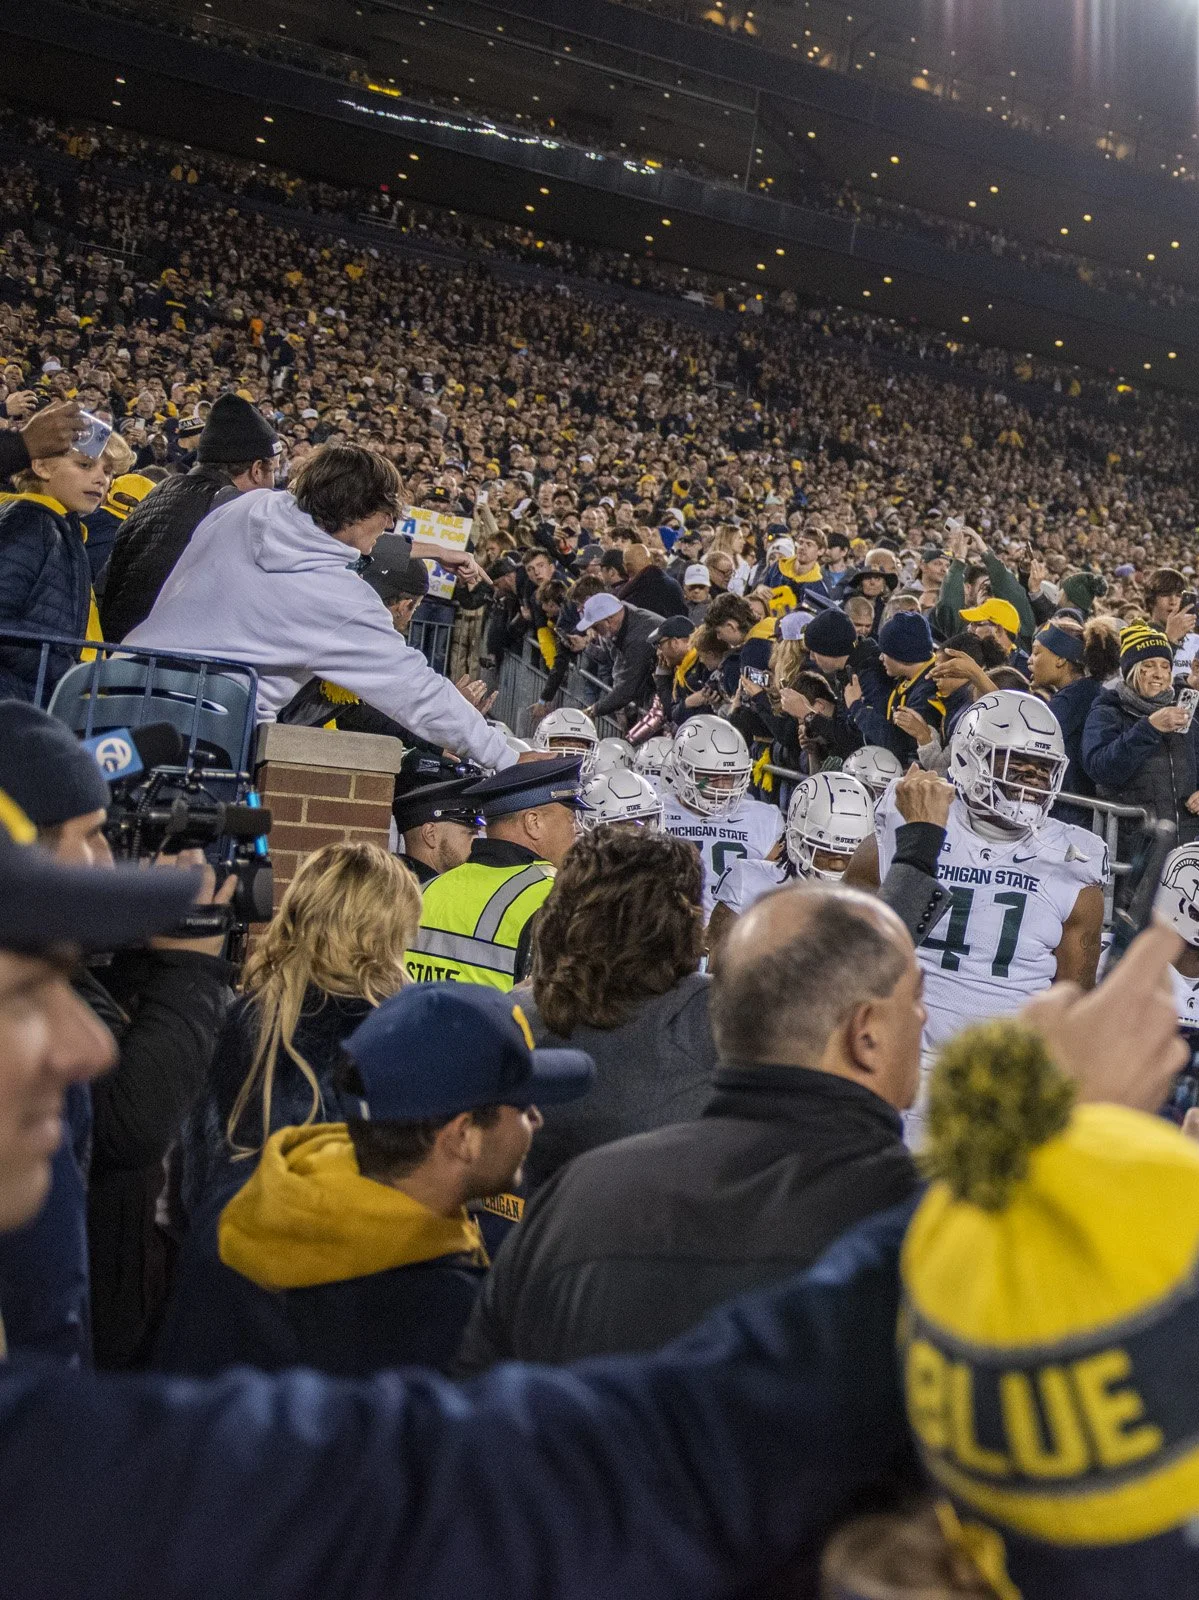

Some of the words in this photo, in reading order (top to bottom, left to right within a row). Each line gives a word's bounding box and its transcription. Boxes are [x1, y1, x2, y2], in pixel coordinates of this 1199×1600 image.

[719, 828, 749, 842] STATE
[937, 864, 992, 885] CHIGAN
[994, 870, 1041, 893] STATE
[919, 885, 1028, 978] 41
[904, 1346, 1164, 1478] BLUE
